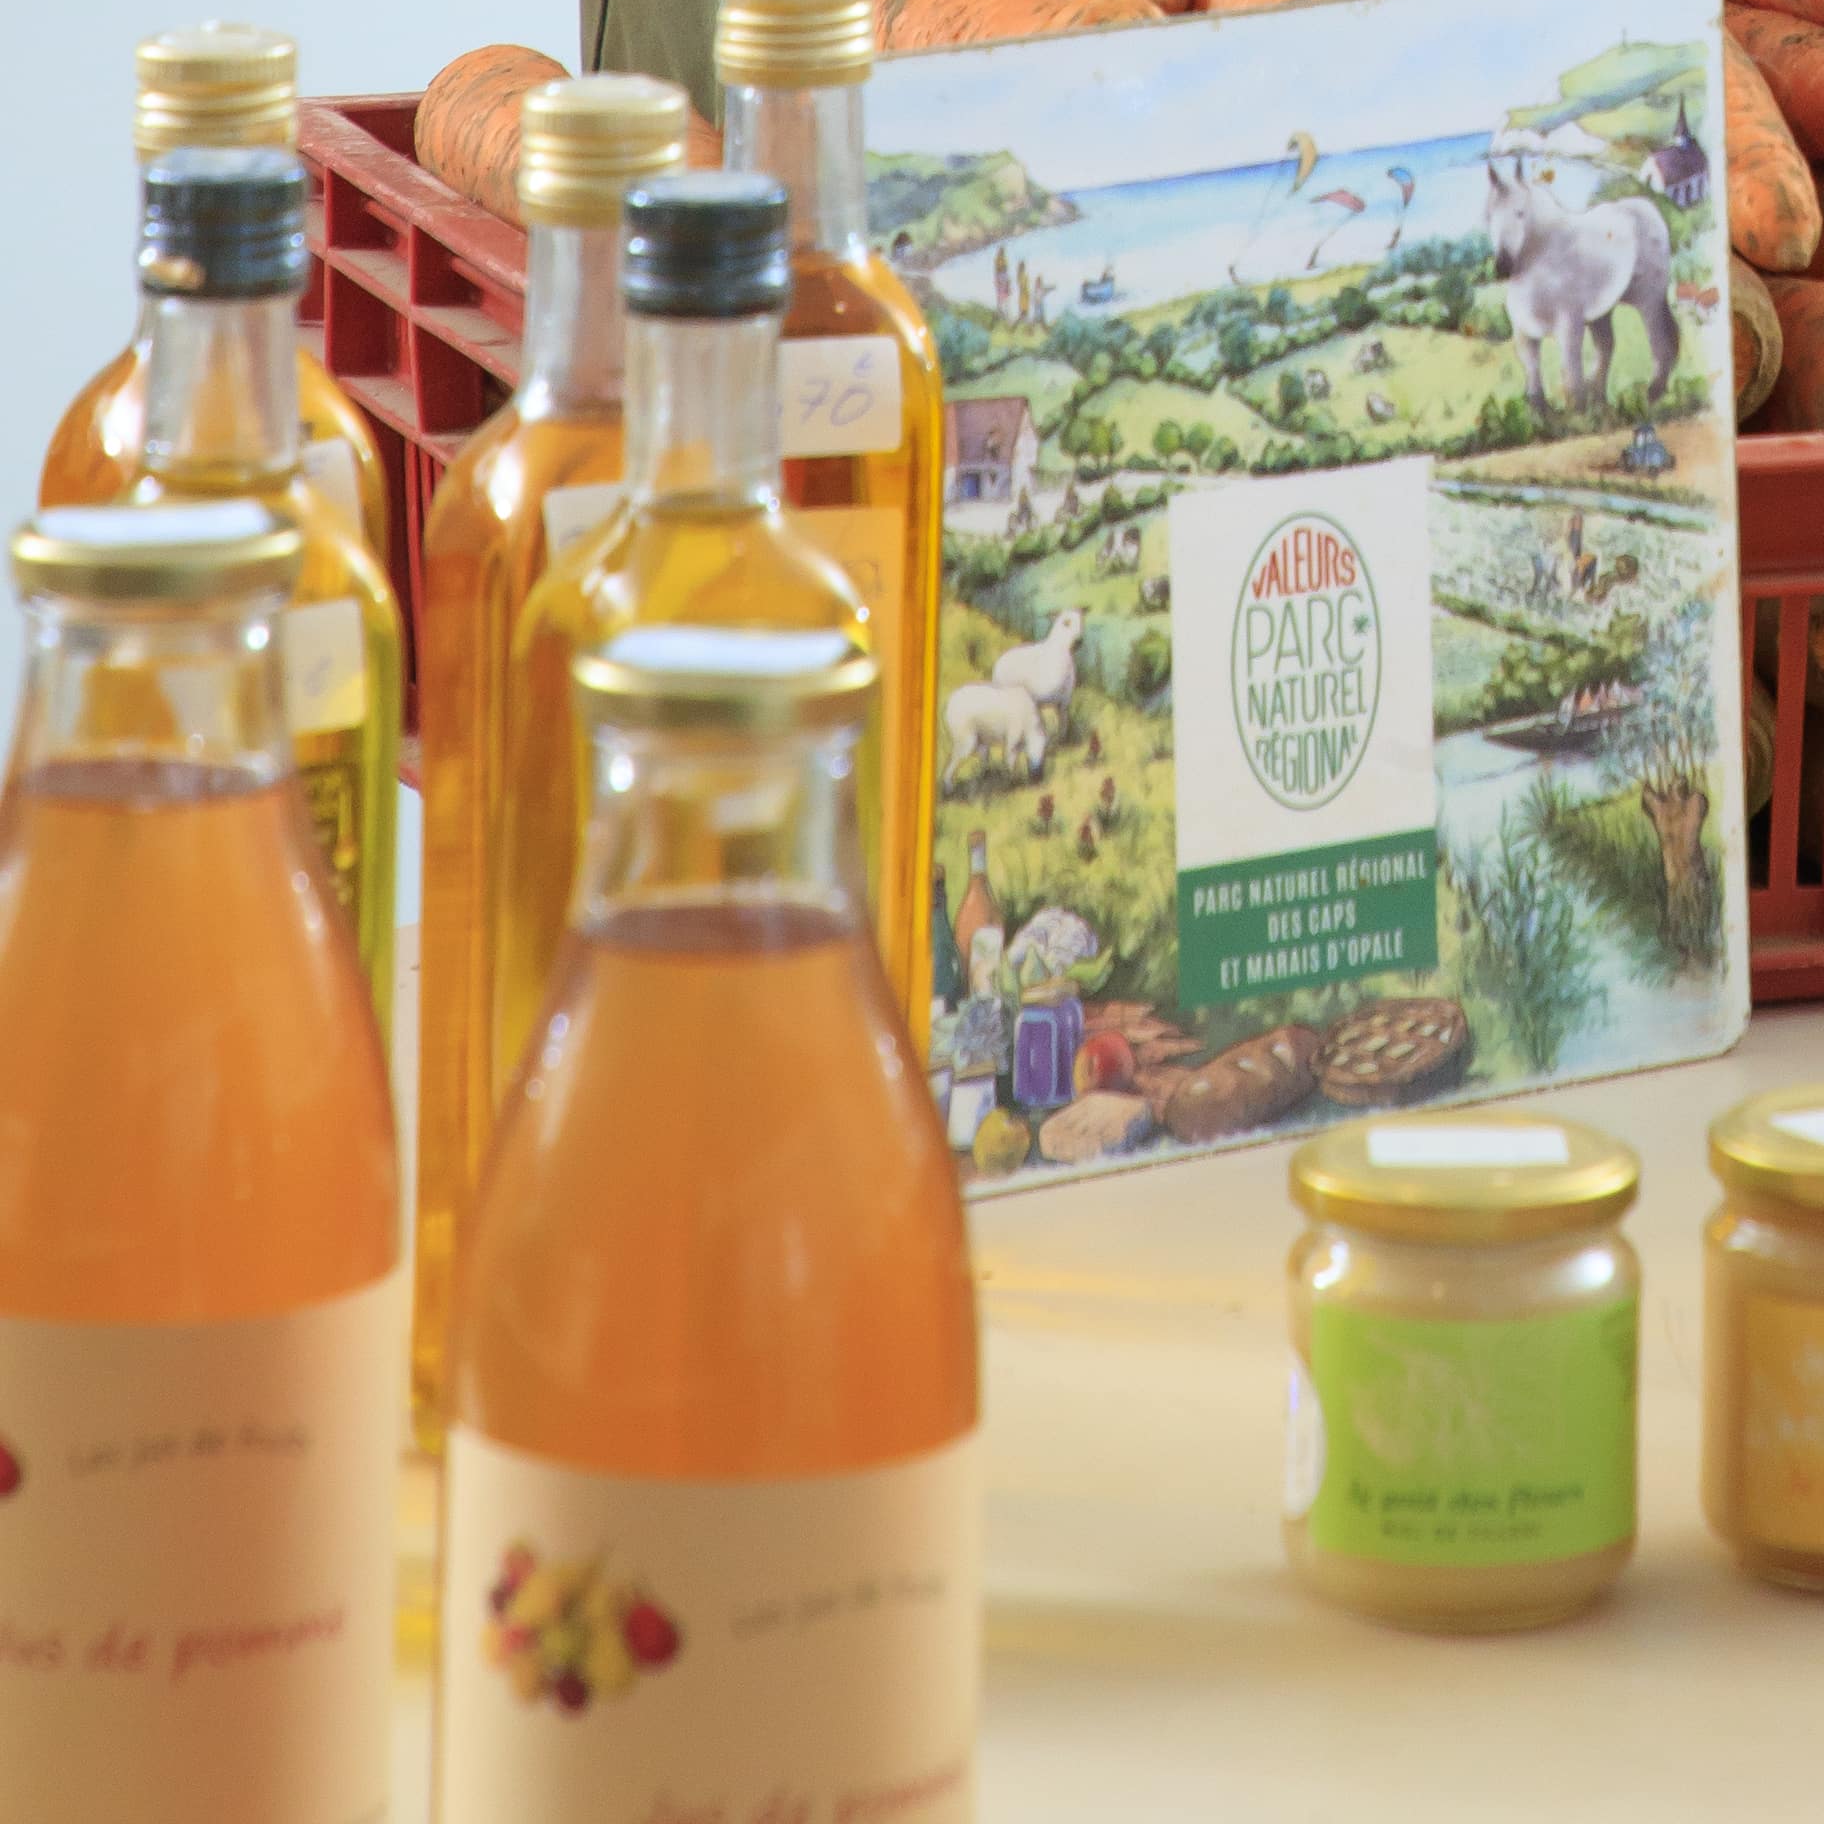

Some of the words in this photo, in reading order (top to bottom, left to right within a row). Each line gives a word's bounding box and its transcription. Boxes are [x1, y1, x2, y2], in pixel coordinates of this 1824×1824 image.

[1252, 527, 1356, 600] VALEURS
[1245, 589, 1366, 677] PARC
[1247, 665, 1367, 730] NATUREL
[1254, 724, 1359, 795] RÉGIONAL
[1193, 882, 1243, 920] PARC
[1249, 867, 1329, 908] NATUREL
[1335, 851, 1427, 893] RÉGIONAL
[1267, 909, 1302, 943] DES
[1308, 899, 1356, 936] CAPS
[1220, 957, 1242, 990] ET
[1246, 943, 1321, 985] MARAIS
[1326, 927, 1404, 971] D'OPALE
